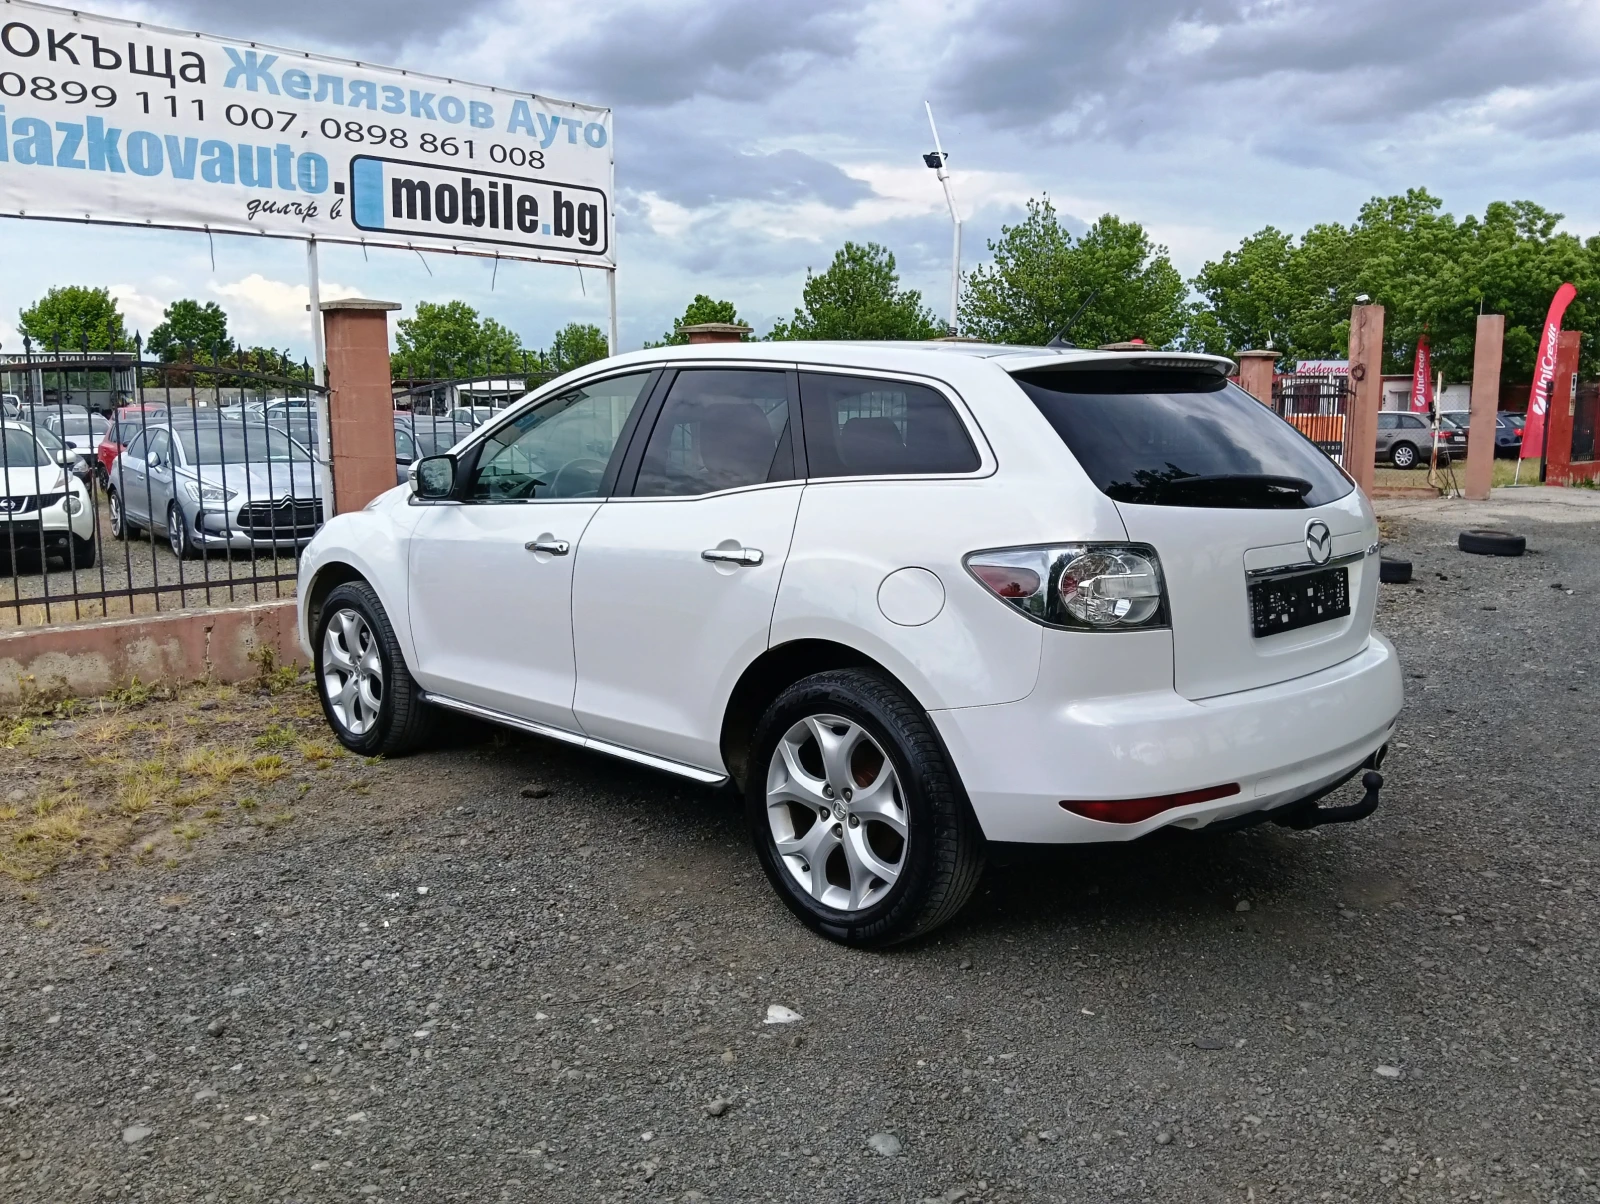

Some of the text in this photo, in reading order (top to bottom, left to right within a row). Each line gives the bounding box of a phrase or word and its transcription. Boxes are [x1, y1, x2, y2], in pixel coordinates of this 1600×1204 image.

[0, 71, 546, 170] 0899 111 007, 0898 861 008
[1, 21, 608, 150] окъща Желязков Ауто
[246, 199, 319, 223] дилър
[391, 177, 598, 247] mobile.bg
[1416, 349, 1425, 394] UniCredit
[1535, 323, 1557, 395] UniCredit
